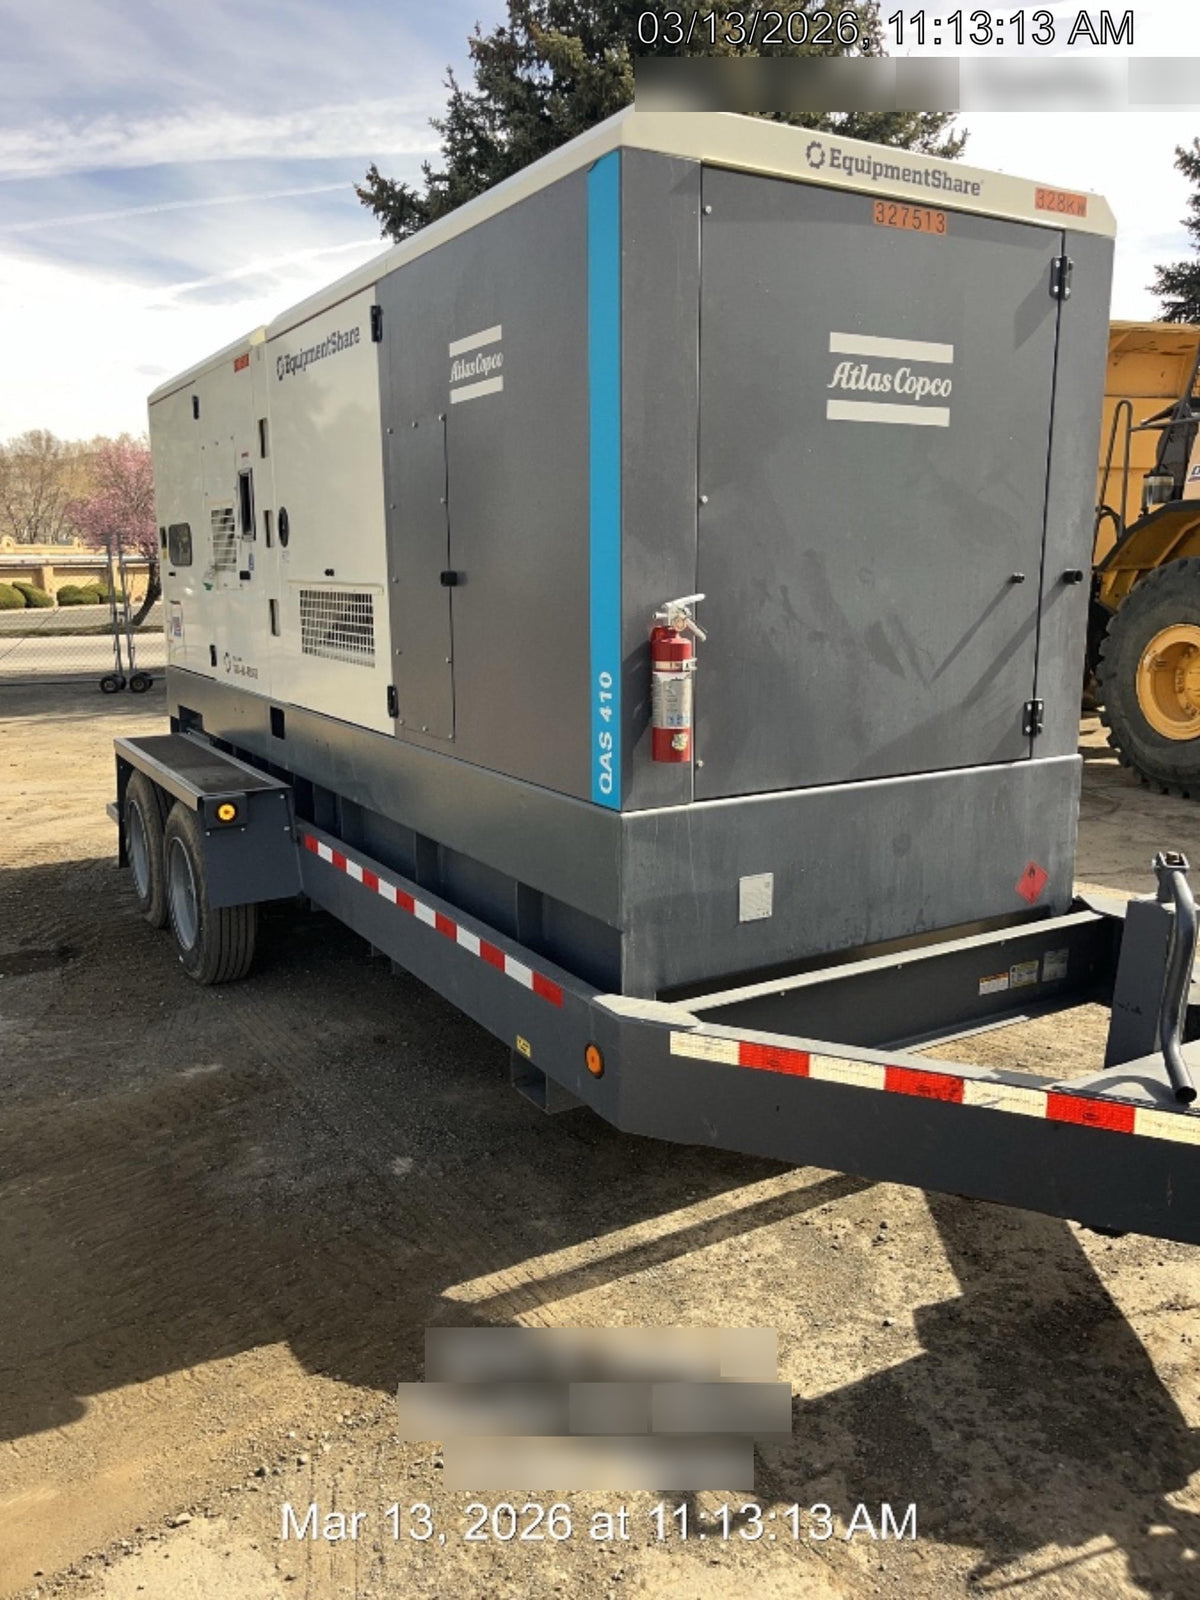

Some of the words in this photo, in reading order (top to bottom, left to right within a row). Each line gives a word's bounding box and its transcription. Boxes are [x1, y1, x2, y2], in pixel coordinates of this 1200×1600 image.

[829, 147, 981, 196] EquipmentShare
[875, 202, 945, 233] 327513
[284, 326, 361, 376] EquipmentShare
[449, 358, 475, 383] Atlas
[475, 352, 504, 376] Copco
[827, 361, 892, 392] Atlas
[893, 367, 952, 401] Copco
[599, 671, 613, 722] 410
[599, 731, 613, 794] QAS
